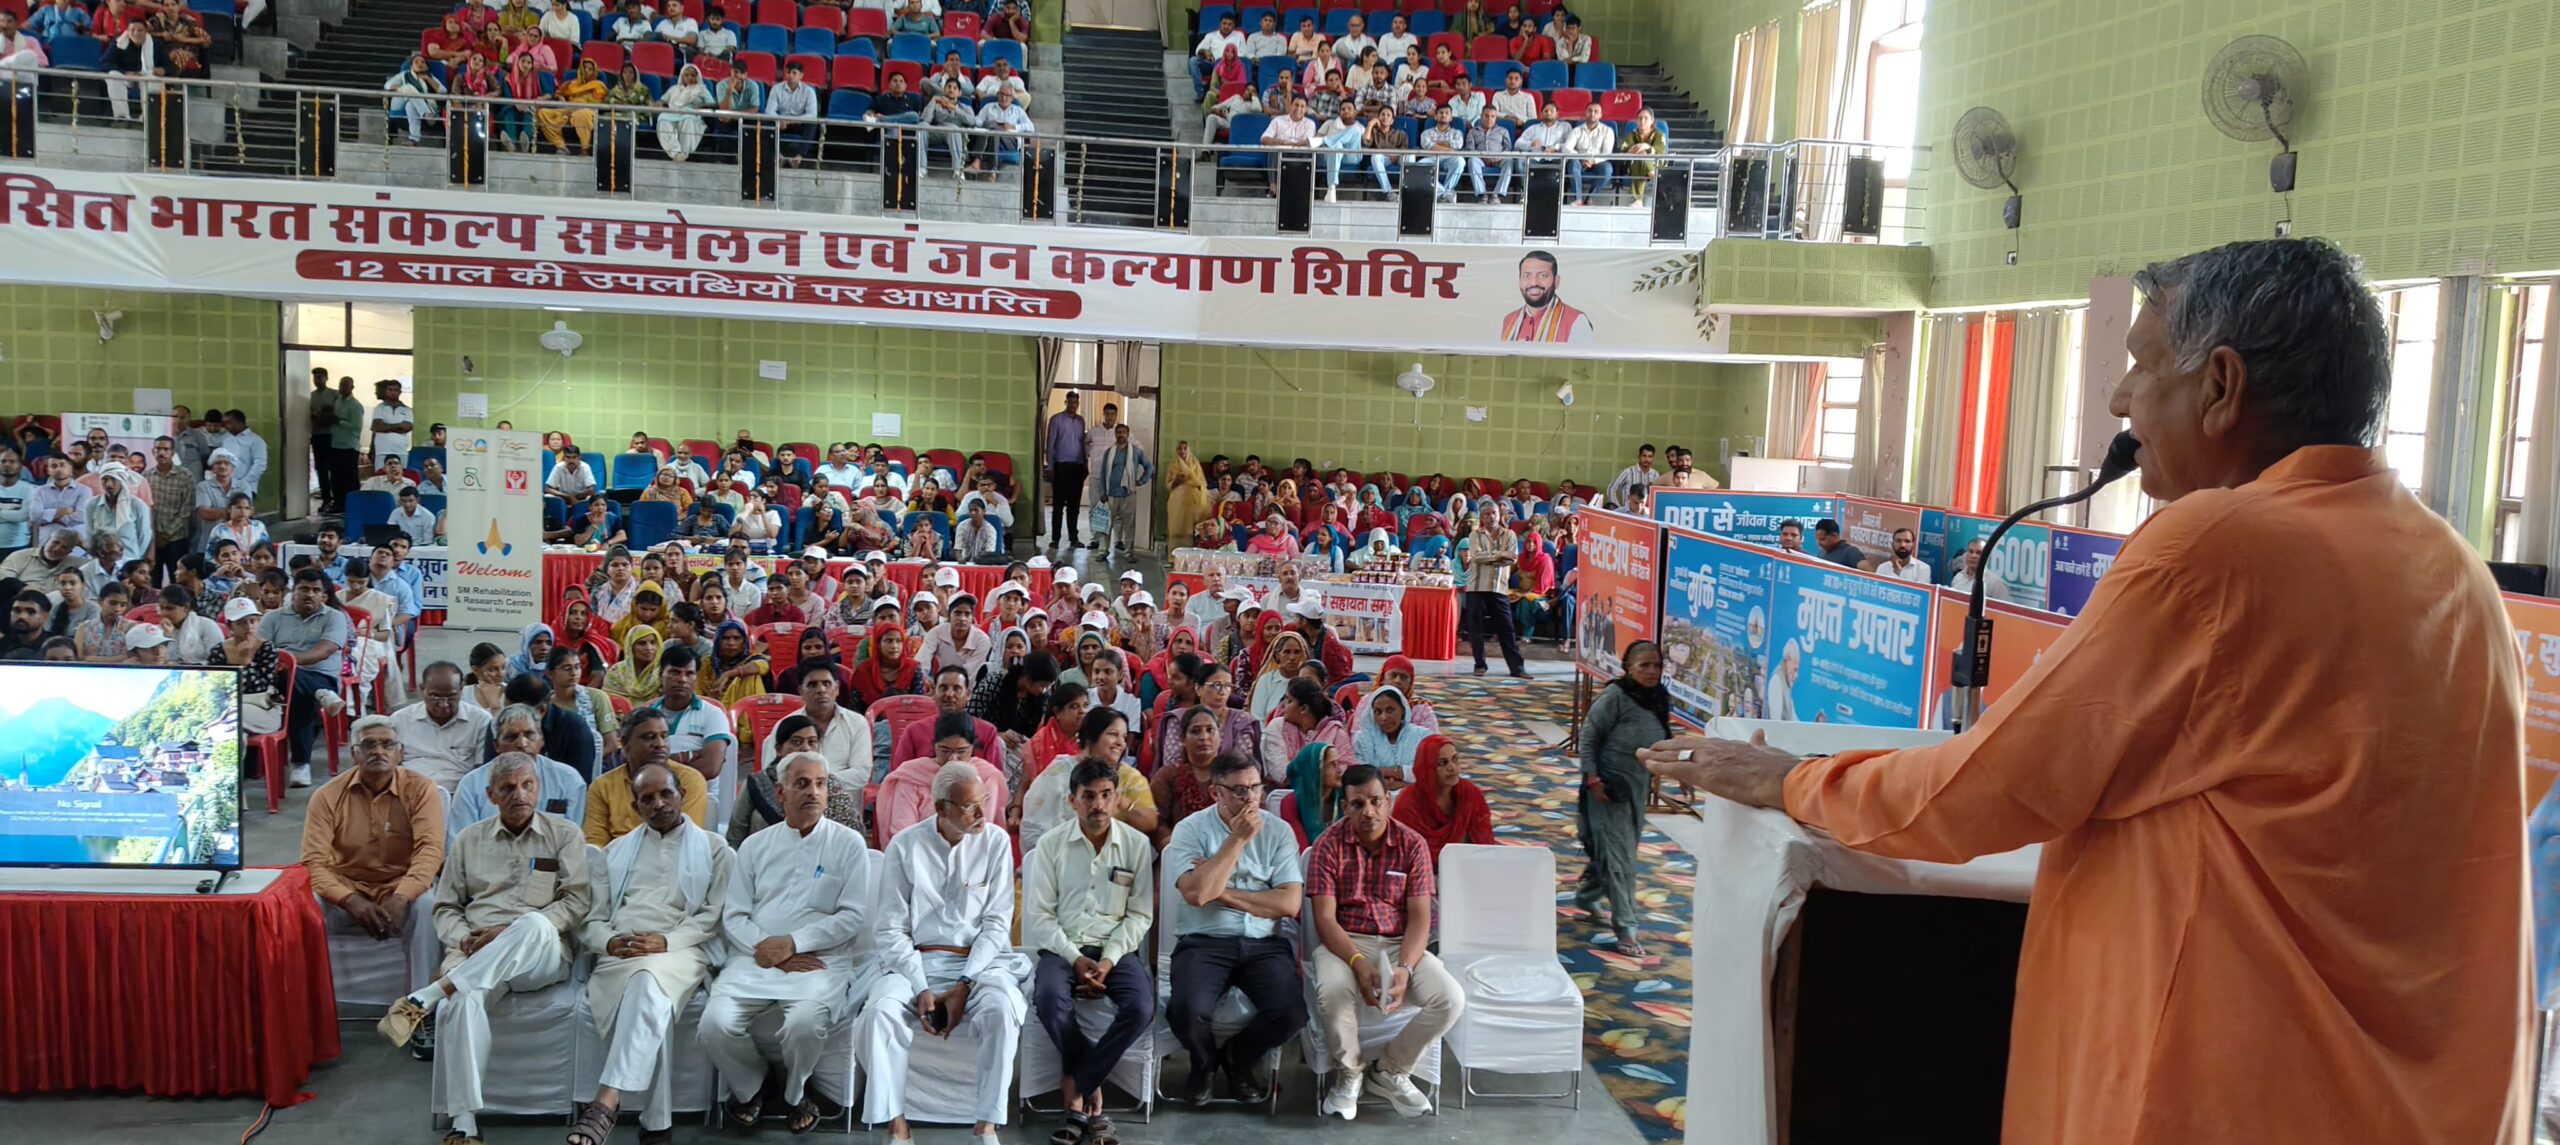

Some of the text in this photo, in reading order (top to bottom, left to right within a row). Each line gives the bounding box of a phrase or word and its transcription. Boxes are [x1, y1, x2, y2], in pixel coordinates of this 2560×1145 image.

[151, 195, 317, 242] भारत
[327, 192, 545, 252] संकल्प
[556, 208, 809, 268] सम्मेलन
[819, 223, 920, 274] एवं
[925, 238, 1038, 281] जन
[1048, 246, 1283, 294] कल्याण
[1290, 246, 1466, 300] शिविर
[334, 259, 1051, 315] 12 साल की उपलब्धियों पर आधारित
[1664, 505, 1710, 531] DBT
[1711, 502, 1736, 532] से
[1736, 510, 1767, 528] जीवन
[456, 560, 534, 579] Welcome
[454, 595, 534, 608] & Research Centre
[457, 586, 532, 598] SM Rehabilitation
[1687, 563, 1717, 618] मुक्ति
[495, 606, 522, 615] Haryana
[1330, 595, 1368, 612] सहायता
[1371, 598, 1394, 617] समूह
[1848, 598, 1920, 666] उपचार
[57, 799, 102, 811] No Signal
